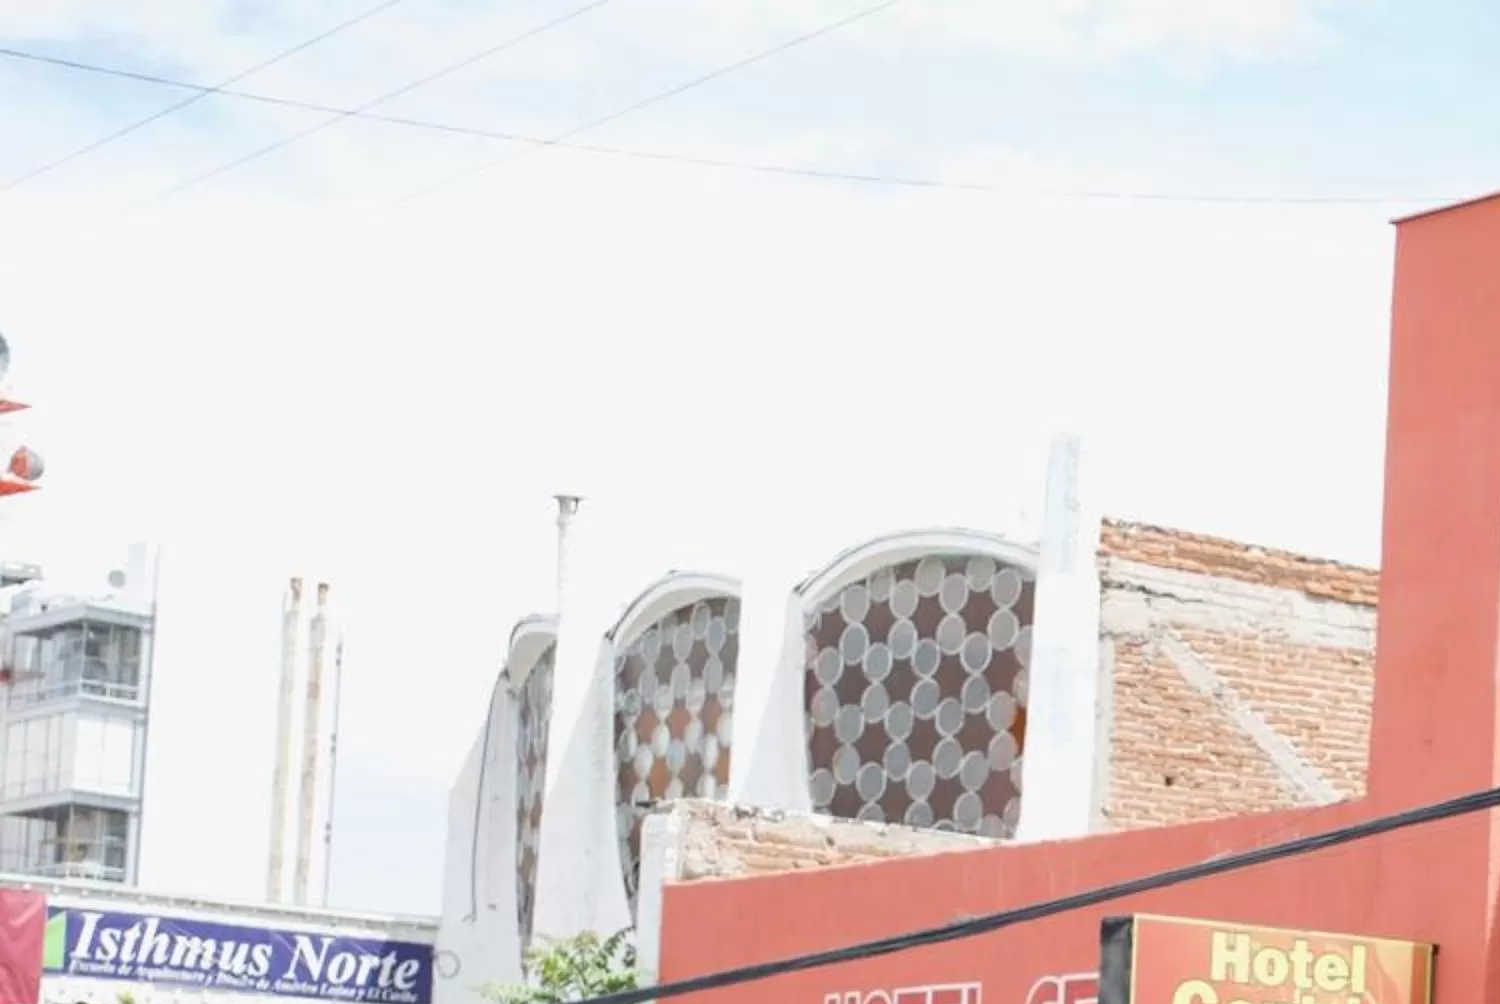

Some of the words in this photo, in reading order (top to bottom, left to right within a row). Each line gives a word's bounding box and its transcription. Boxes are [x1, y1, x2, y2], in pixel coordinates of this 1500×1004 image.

[70, 912, 273, 977] Isthmus
[284, 935, 420, 989] Norte
[1211, 930, 1367, 993] Hotel
